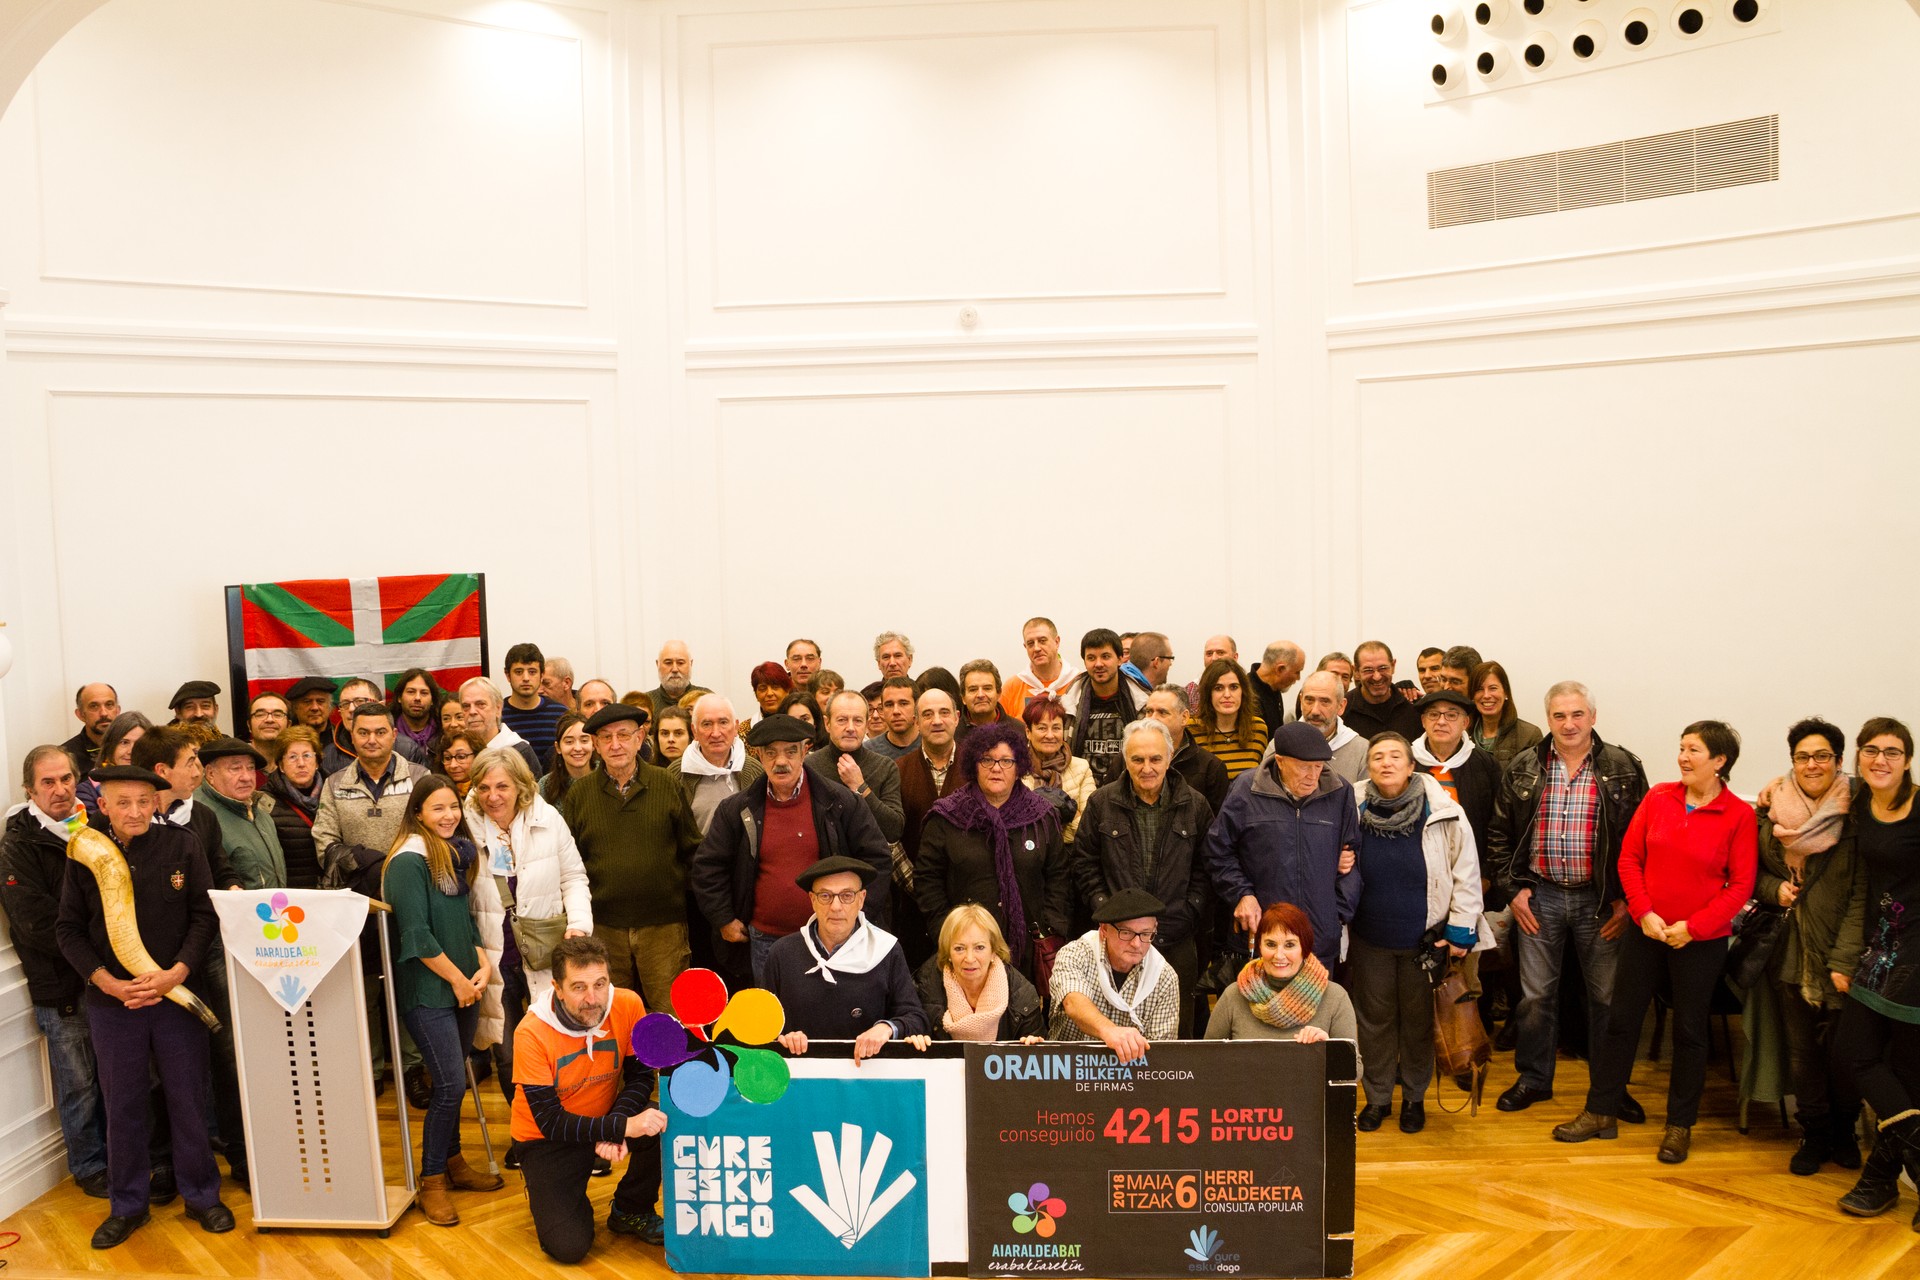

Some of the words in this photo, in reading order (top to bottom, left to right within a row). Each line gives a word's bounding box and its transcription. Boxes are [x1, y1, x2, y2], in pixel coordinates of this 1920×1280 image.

[256, 945, 318, 958] AIARALDEABAT
[984, 1054, 1071, 1081] ORAIN
[1075, 1068, 1133, 1080] BILKETA
[1136, 1071, 1195, 1080] RECOGIDA
[1075, 1082, 1090, 1092] DE
[1094, 1082, 1135, 1092] FIRMAS
[1036, 1109, 1095, 1125] Hemos
[1211, 1108, 1283, 1123] LORTU
[1103, 1107, 1200, 1144] 4215
[999, 1126, 1095, 1146] conseguido
[1211, 1126, 1294, 1141] DITUGU
[673, 1135, 772, 1169] GURE
[1127, 1174, 1174, 1190] MAIA
[1204, 1170, 1253, 1185] HERRI
[674, 1169, 773, 1203] ESKU
[1113, 1174, 1125, 1208] 2018
[1175, 1175, 1198, 1209] 6
[1204, 1186, 1303, 1201] GALDEKETA
[1127, 1193, 1173, 1208] TZAK
[1204, 1202, 1255, 1213] CONSULTA
[1258, 1201, 1304, 1212] POPULAR
[675, 1202, 774, 1238] DAGO
[992, 1243, 1081, 1257] AIARALDEABAT
[988, 1258, 1084, 1271] erabakiarekin
[1214, 1253, 1240, 1264] gure
